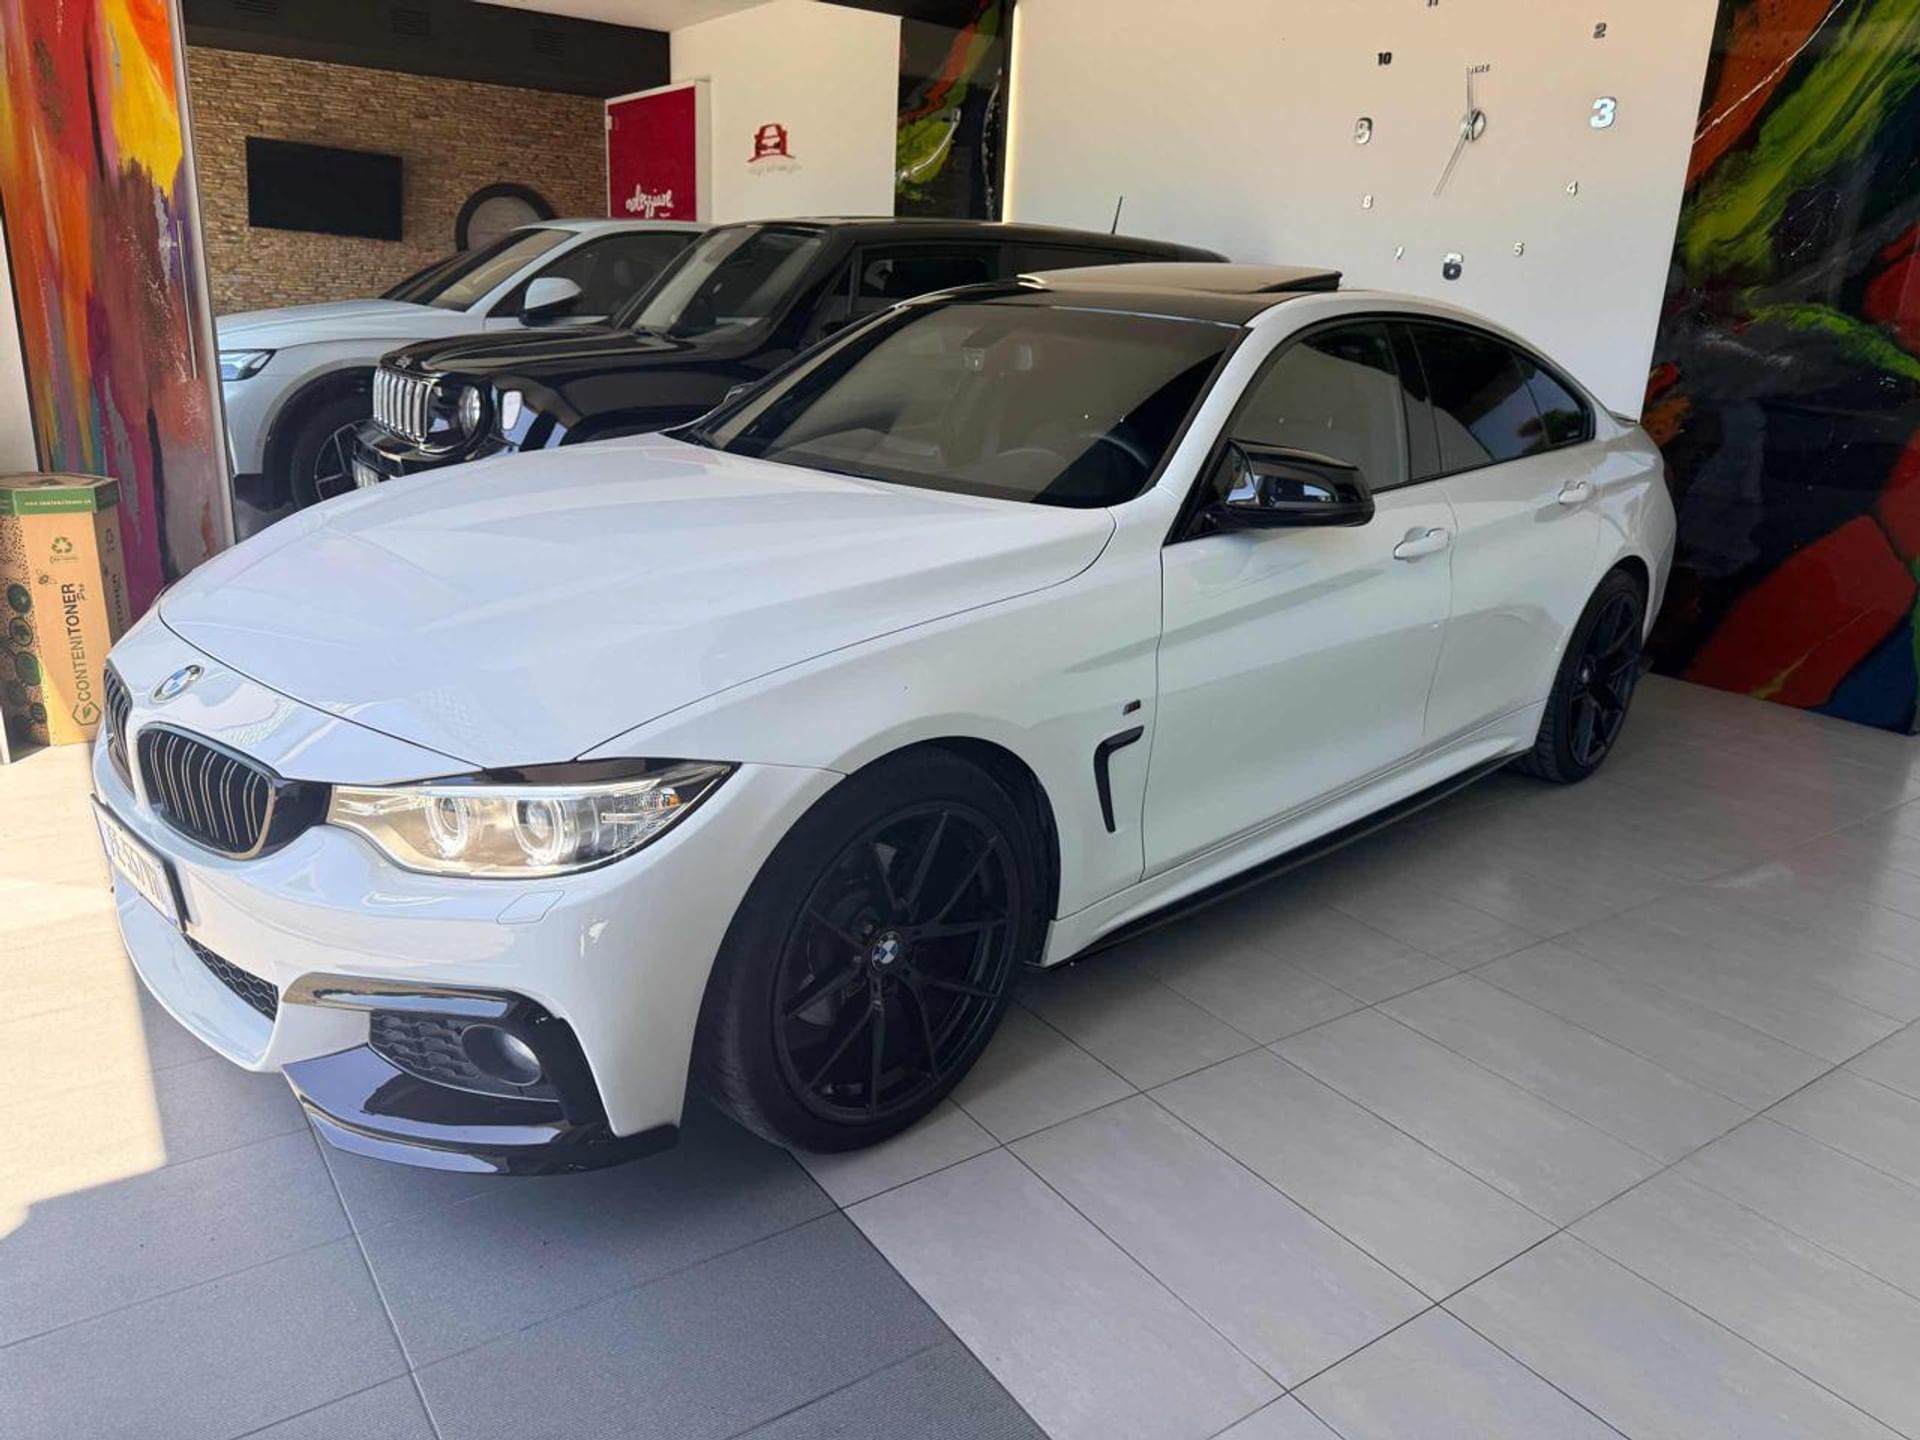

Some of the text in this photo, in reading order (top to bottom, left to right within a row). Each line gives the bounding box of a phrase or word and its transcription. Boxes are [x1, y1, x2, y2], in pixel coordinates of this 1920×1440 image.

[1593, 22, 1607, 38] 2
[1377, 52, 1392, 66] 10
[1590, 96, 1617, 129] 3
[1354, 117, 1373, 144] 9
[1565, 180, 1579, 196] 4
[1513, 241, 1525, 256] 5
[1442, 252, 1464, 281] 6
[61, 583, 91, 702] CONTENITONER
